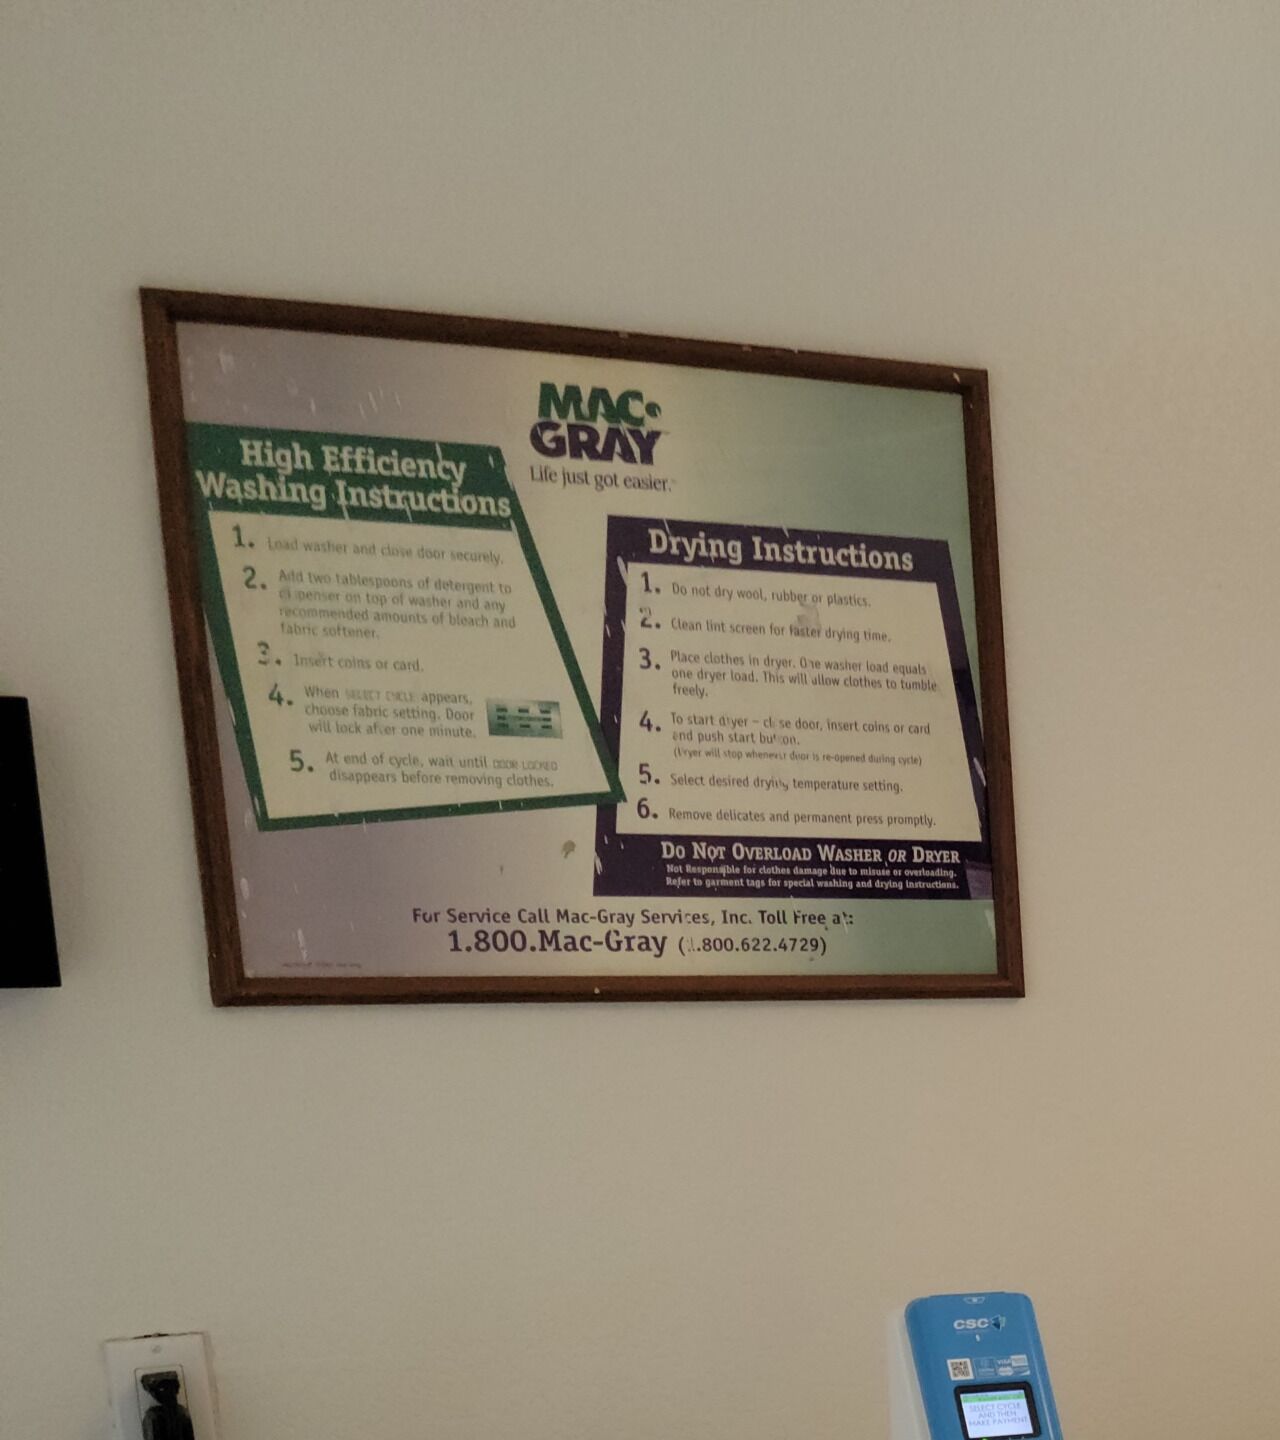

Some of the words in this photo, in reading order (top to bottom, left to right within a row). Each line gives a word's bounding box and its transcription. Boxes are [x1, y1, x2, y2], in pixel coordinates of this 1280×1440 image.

[530, 420, 662, 466] GRAY
[239, 438, 312, 478] High
[322, 443, 466, 485] Efficiency
[530, 465, 557, 485] Life
[561, 467, 589, 491] just
[593, 470, 618, 492] got
[622, 472, 672, 491] easier.
[196, 470, 326, 510] Washing
[336, 480, 512, 518] Instructions
[231, 524, 254, 549] 1.
[267, 536, 298, 553] Load
[302, 538, 347, 556] washer
[352, 541, 376, 557] and
[380, 542, 413, 559] close
[415, 544, 445, 561] door
[449, 546, 504, 568] securely.
[648, 528, 742, 567] Drying
[752, 537, 914, 571] Instructions
[242, 566, 268, 591] 2.
[640, 572, 660, 594] 1.
[672, 583, 687, 596] Do
[690, 584, 711, 598] not
[713, 586, 733, 602] dry
[736, 587, 766, 602] wool,
[770, 589, 807, 603] rubber
[810, 594, 822, 604] or
[826, 593, 870, 610] plastics.
[670, 618, 702, 632] Clean
[705, 620, 726, 633] lint
[728, 624, 765, 635] screen
[769, 623, 784, 636] for
[788, 624, 822, 638] faster
[824, 625, 860, 644] drying
[862, 627, 892, 642] time.
[292, 652, 334, 669] Insert
[337, 654, 372, 670] coins
[374, 659, 388, 671] or
[392, 656, 424, 672] card.
[638, 646, 661, 670] 3.
[670, 650, 700, 664] Place
[703, 652, 744, 667] clothes
[748, 654, 759, 667] in
[762, 655, 795, 672] dryer.
[824, 658, 861, 673] washer
[865, 660, 888, 674] load
[892, 662, 926, 679] equals
[268, 683, 294, 707] 4.
[304, 684, 339, 701] When
[421, 692, 472, 708] appears,
[672, 682, 708, 700] freely.
[304, 704, 349, 718] choose
[352, 705, 388, 719] fabric
[392, 706, 440, 723] setting.
[444, 707, 474, 721] Door
[638, 710, 662, 733] 4.
[289, 750, 314, 774] 5.
[325, 751, 339, 765] At
[343, 752, 367, 766] end
[370, 753, 384, 767] of
[388, 753, 423, 771] cycle,
[428, 755, 453, 769] wait
[458, 756, 487, 769] until
[328, 768, 396, 788] disappears
[400, 770, 442, 785] before
[444, 771, 502, 789] removing
[506, 773, 554, 787] clothes.
[638, 763, 660, 785] 5.
[670, 774, 704, 787] Select
[708, 774, 749, 788] desired
[792, 777, 859, 794] temperature
[862, 778, 904, 795] setting.
[637, 798, 658, 820] 6.
[668, 808, 712, 822] Remove
[715, 809, 765, 823] delicates
[768, 810, 790, 823] and
[793, 811, 852, 828] permanent
[855, 815, 883, 828] press
[886, 813, 936, 829] promptly.
[412, 908, 439, 923] For
[446, 909, 510, 924] Service
[516, 909, 549, 924] Call
[555, 909, 635, 928] Mac-Gray
[721, 910, 751, 925] Inc.
[758, 910, 787, 925] Toll
[792, 911, 826, 925] Free
[447, 930, 667, 959] 1.800.Mac-Gray
[953, 1317, 989, 1330] CSC
[997, 1402, 1021, 1410] CYCLE
[993, 1415, 1028, 1425] PAYMENT
